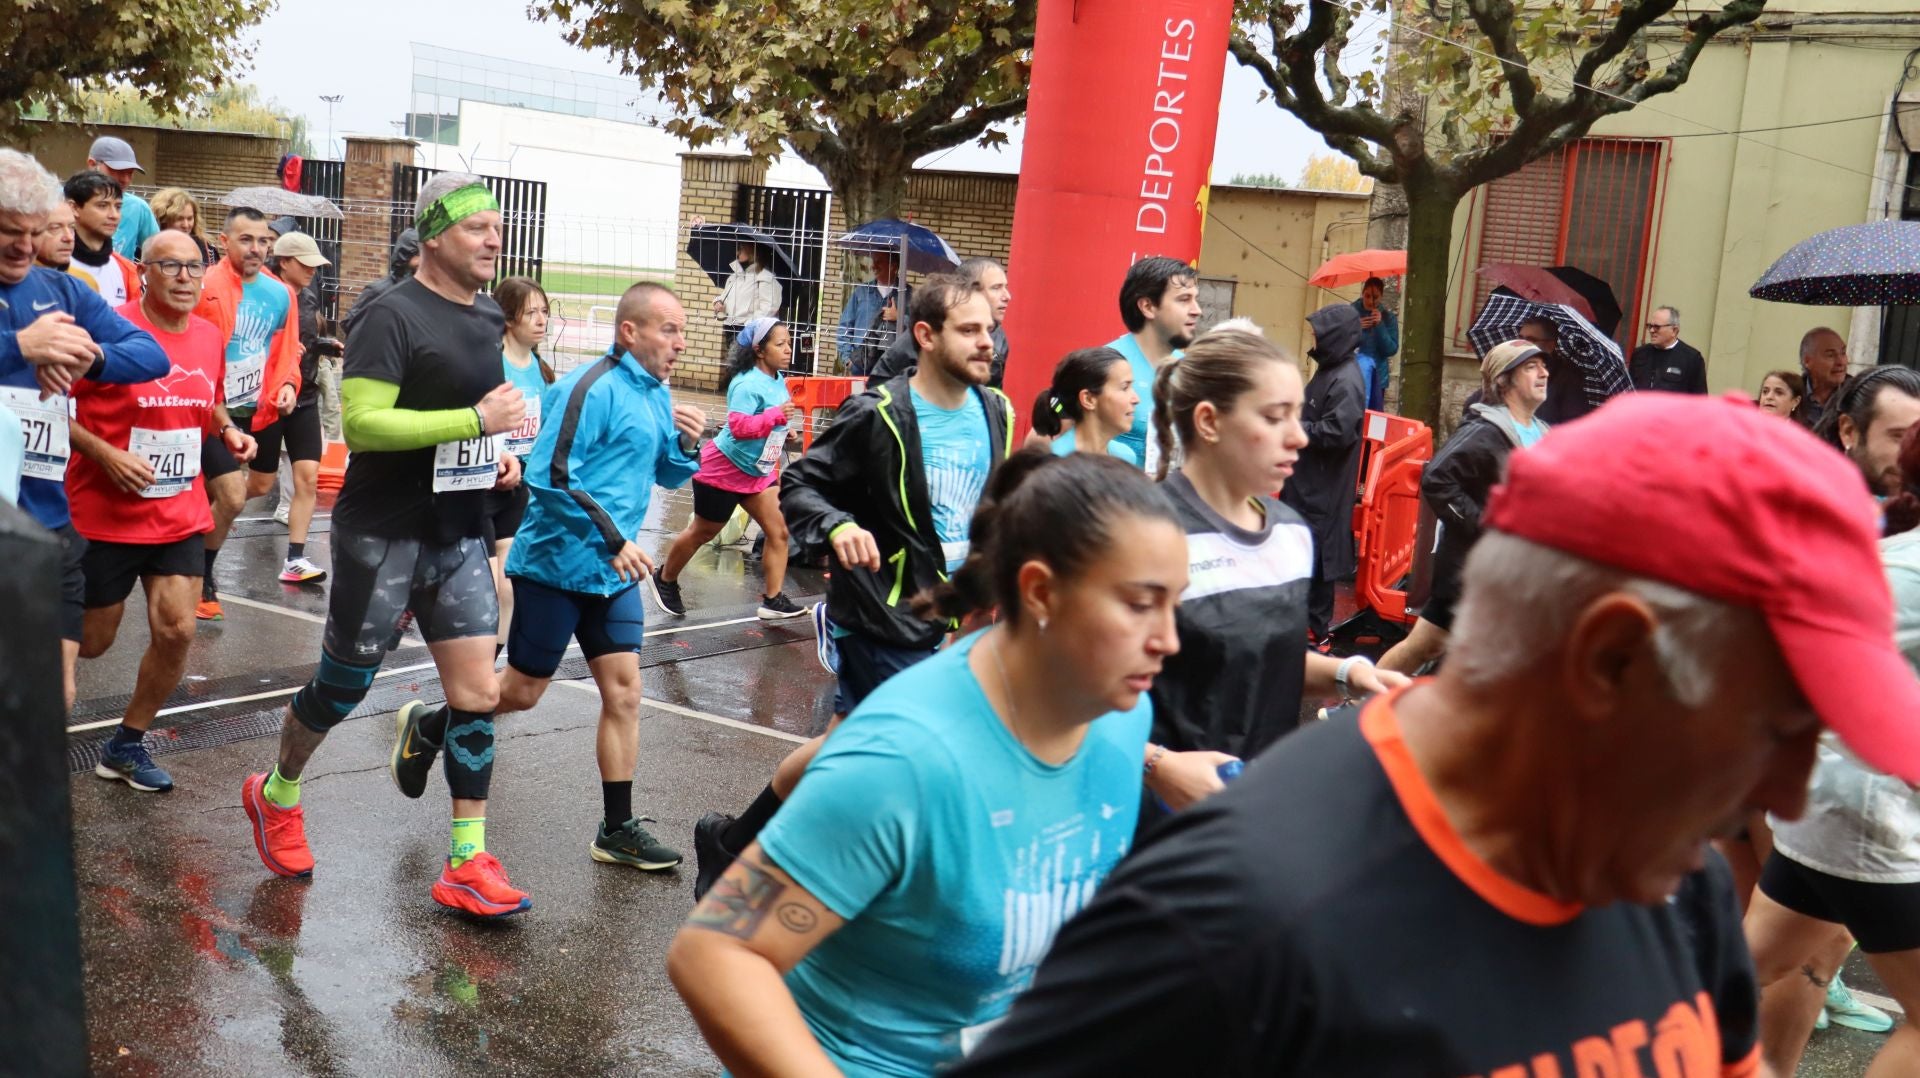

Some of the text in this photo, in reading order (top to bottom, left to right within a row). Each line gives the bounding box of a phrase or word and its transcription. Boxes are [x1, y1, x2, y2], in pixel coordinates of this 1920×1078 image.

[1136, 18, 1195, 234] DEPORTES
[237, 368, 262, 393] 722
[149, 453, 185, 477] 740
[457, 436, 494, 467] 670
